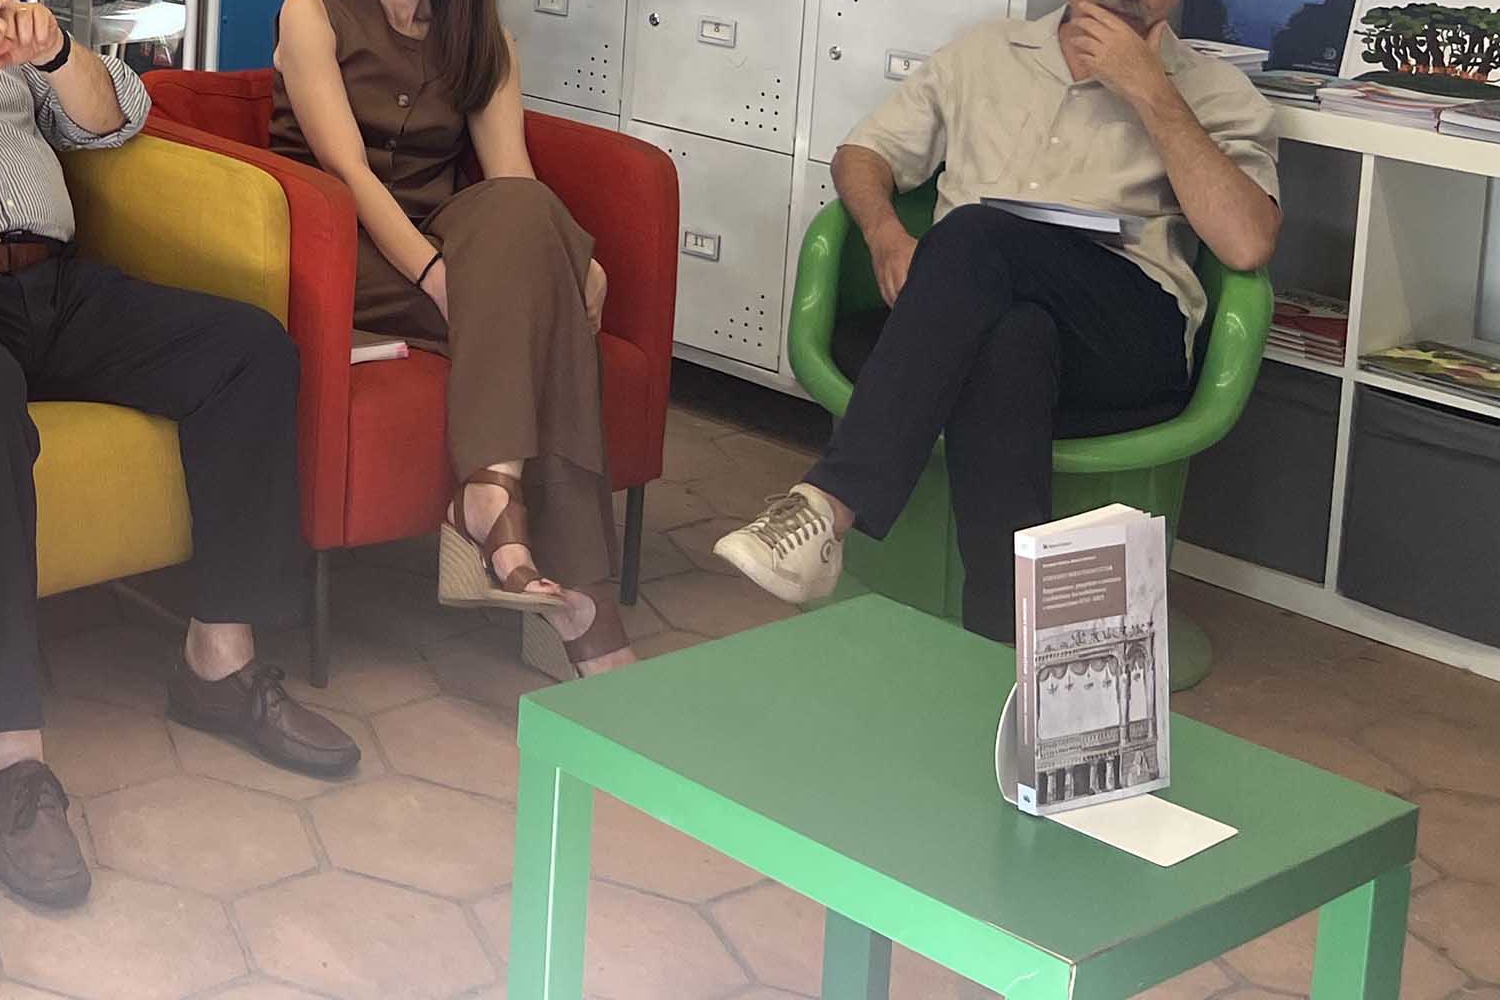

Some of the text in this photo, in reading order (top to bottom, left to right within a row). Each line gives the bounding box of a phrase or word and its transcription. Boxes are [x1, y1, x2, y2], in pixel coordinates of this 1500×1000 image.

[714, 22, 720, 33] 8
[903, 59, 910, 71] 9
[694, 235, 705, 247] 11
